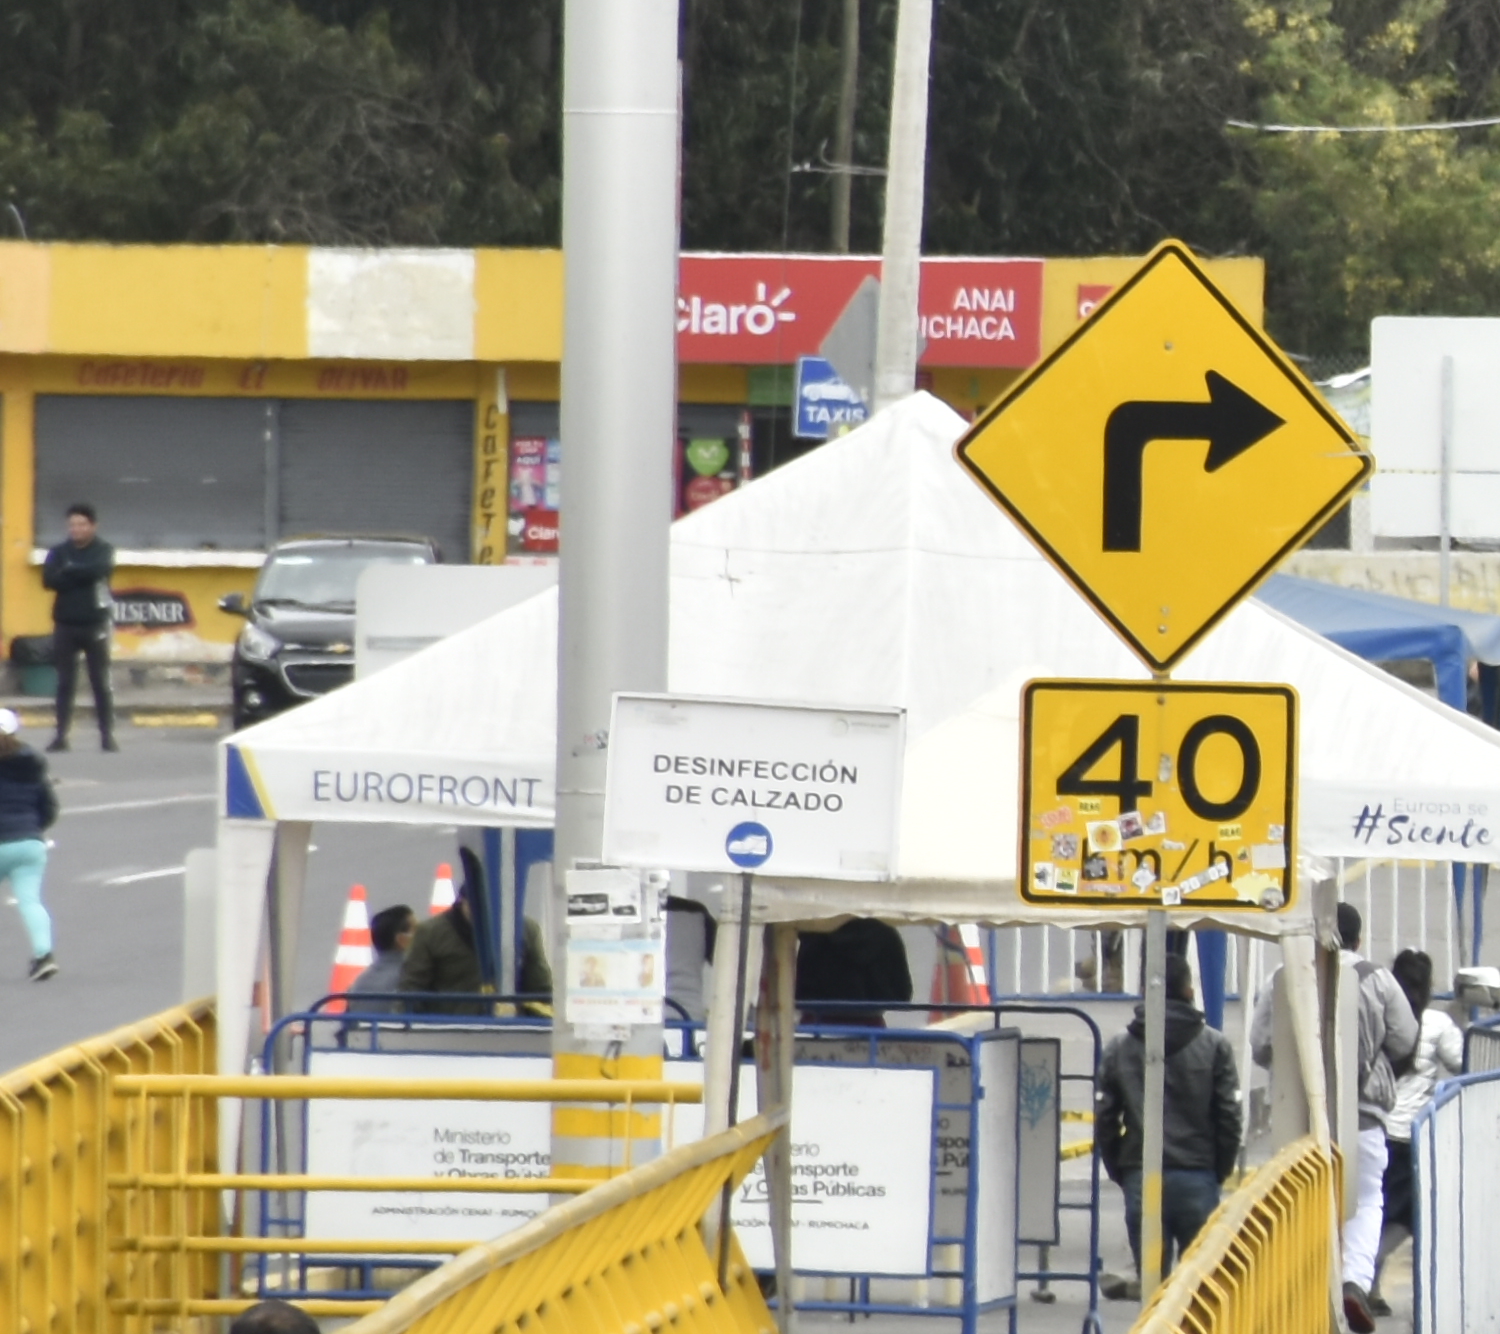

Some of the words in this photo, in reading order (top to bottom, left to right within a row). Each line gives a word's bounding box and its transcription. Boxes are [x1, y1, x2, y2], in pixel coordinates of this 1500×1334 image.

[952, 287, 1016, 313] ANAI
[921, 314, 1016, 341] ICHACA
[804, 405, 864, 425] TAXIS
[527, 524, 561, 541] Clar
[112, 598, 186, 623] ILSENER
[652, 751, 859, 786] DESINFECCIÓN
[1055, 713, 1262, 823] 40
[311, 769, 544, 811] EUROFRONT
[664, 783, 703, 807] DE
[710, 784, 845, 814] CALZADO
[1392, 797, 1462, 816] Europa
[1468, 801, 1489, 816] se
[433, 1127, 512, 1146] Ministerio
[433, 1148, 455, 1165] de
[458, 1148, 551, 1167] Transporte
[813, 1180, 887, 1198] Públicas
